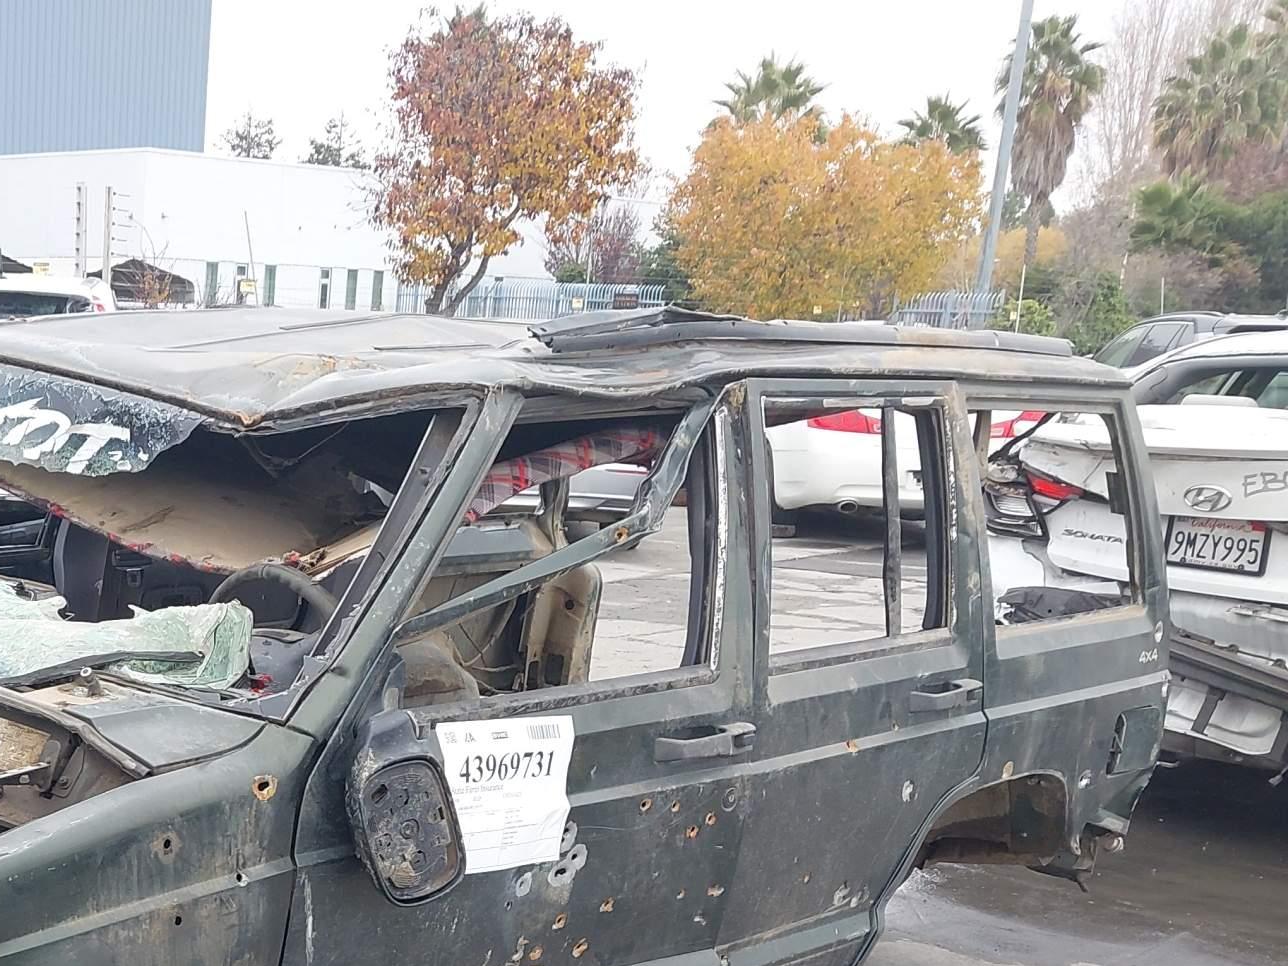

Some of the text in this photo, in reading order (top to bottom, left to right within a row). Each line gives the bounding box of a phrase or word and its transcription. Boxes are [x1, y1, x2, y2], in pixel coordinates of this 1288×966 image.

[1061, 528, 1124, 545] SONATA
[1171, 530, 1260, 565] 9MZY995
[459, 750, 555, 784] 43969731
